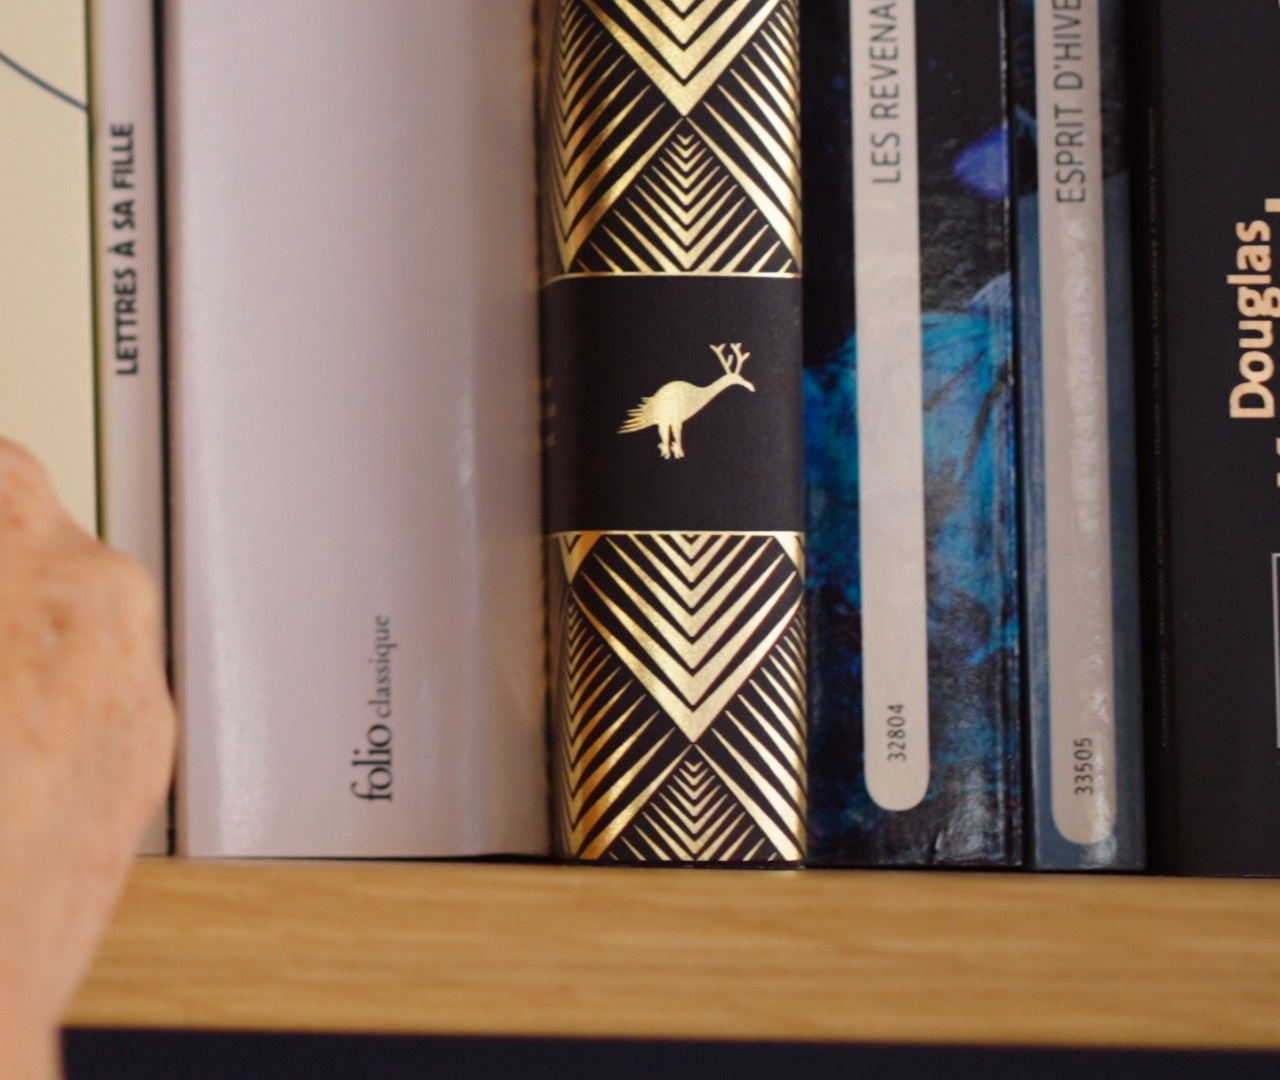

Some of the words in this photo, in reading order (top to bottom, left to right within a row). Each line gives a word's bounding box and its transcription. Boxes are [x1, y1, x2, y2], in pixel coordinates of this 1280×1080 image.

[110, 122, 134, 189] FILLE
[871, 125, 900, 184] LES
[1056, 104, 1086, 204] ESPRIT
[112, 197, 136, 229] SA
[114, 269, 139, 376] LETTRES
[1226, 219, 1280, 419] Douglas
[368, 615, 397, 718] classique
[351, 723, 393, 803] folio
[888, 703, 907, 763] 32804
[1074, 736, 1093, 797] 33505
